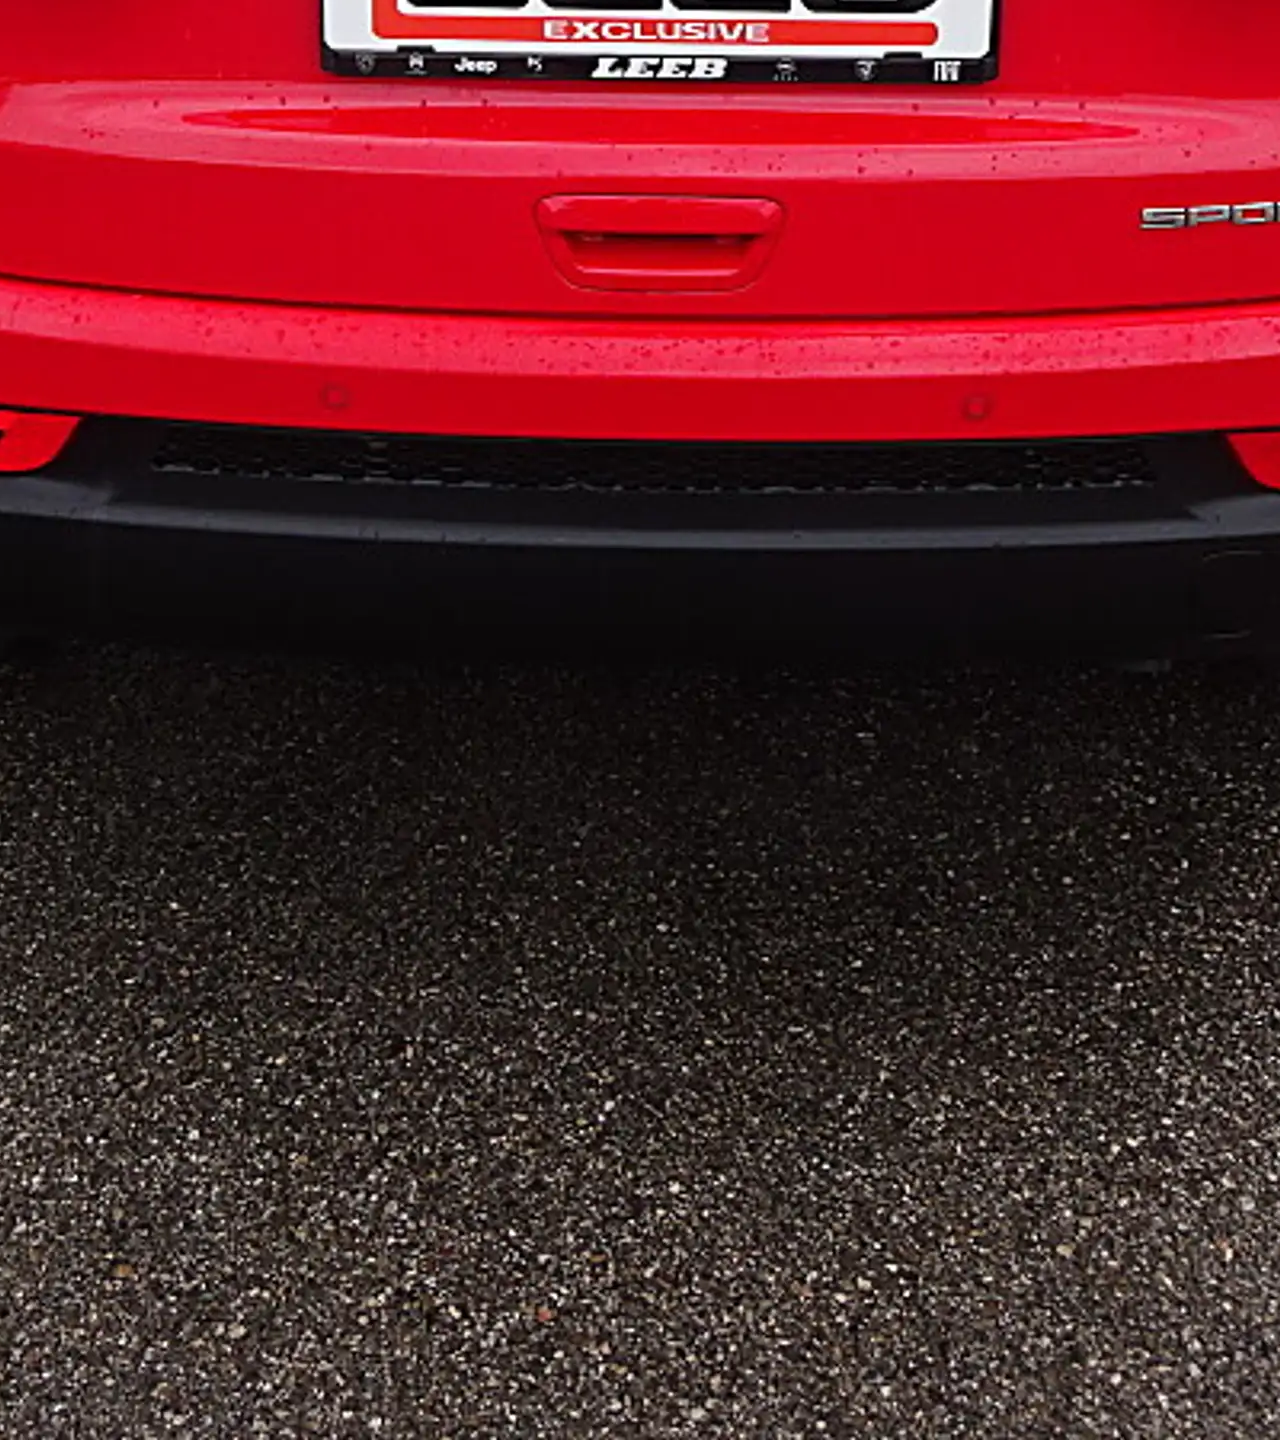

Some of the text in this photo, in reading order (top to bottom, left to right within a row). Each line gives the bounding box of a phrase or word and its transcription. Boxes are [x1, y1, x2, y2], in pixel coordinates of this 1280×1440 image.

[542, 20, 770, 43] EXCLUSIVE
[453, 57, 498, 75] Jeep
[591, 57, 728, 79] LEEB
